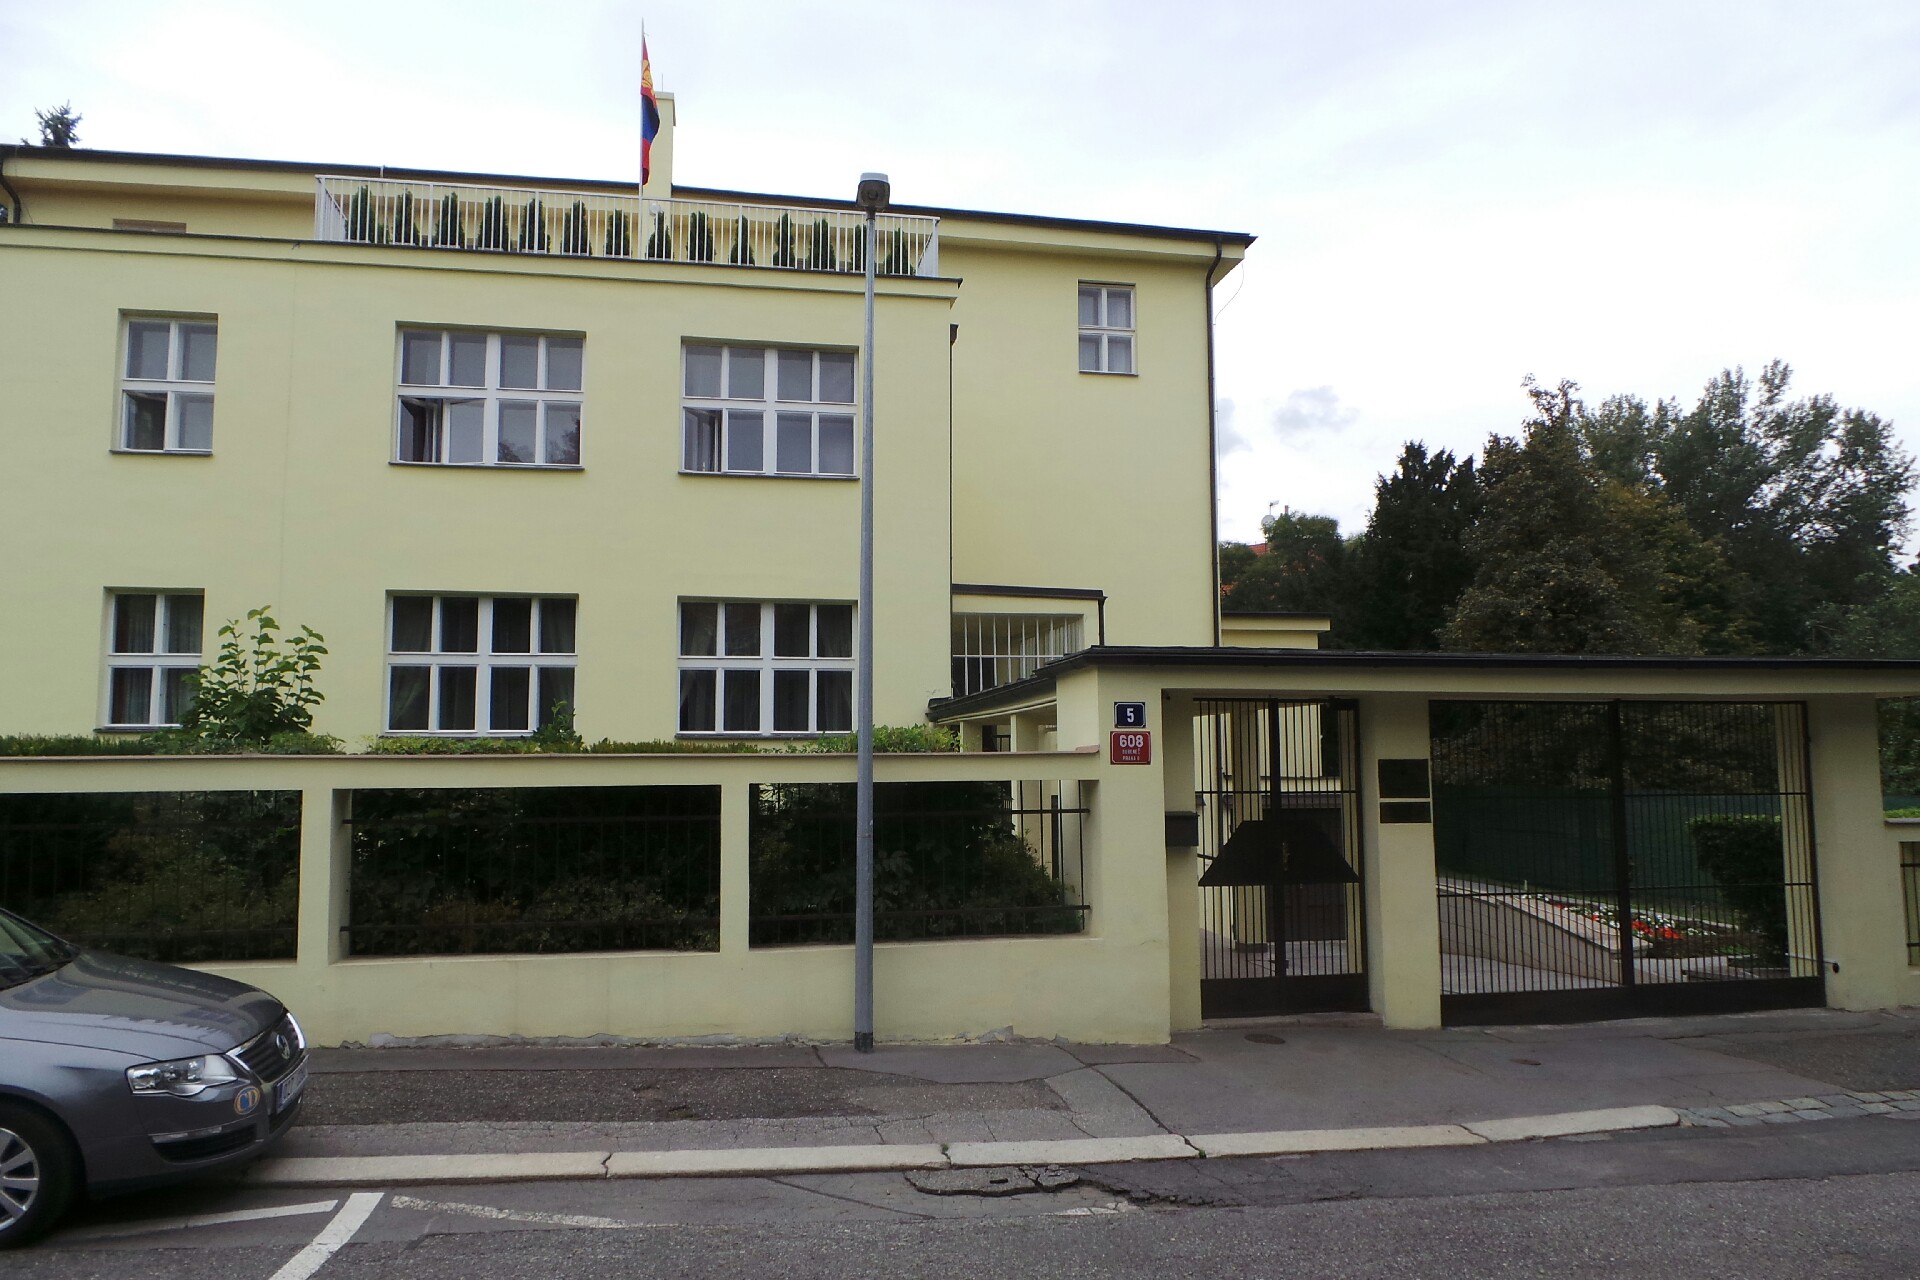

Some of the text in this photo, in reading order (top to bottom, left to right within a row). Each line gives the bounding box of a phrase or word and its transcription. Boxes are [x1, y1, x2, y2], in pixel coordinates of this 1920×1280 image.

[1126, 708, 1135, 722] 5
[1120, 734, 1144, 747] 608
[236, 1089, 259, 1112] CD
